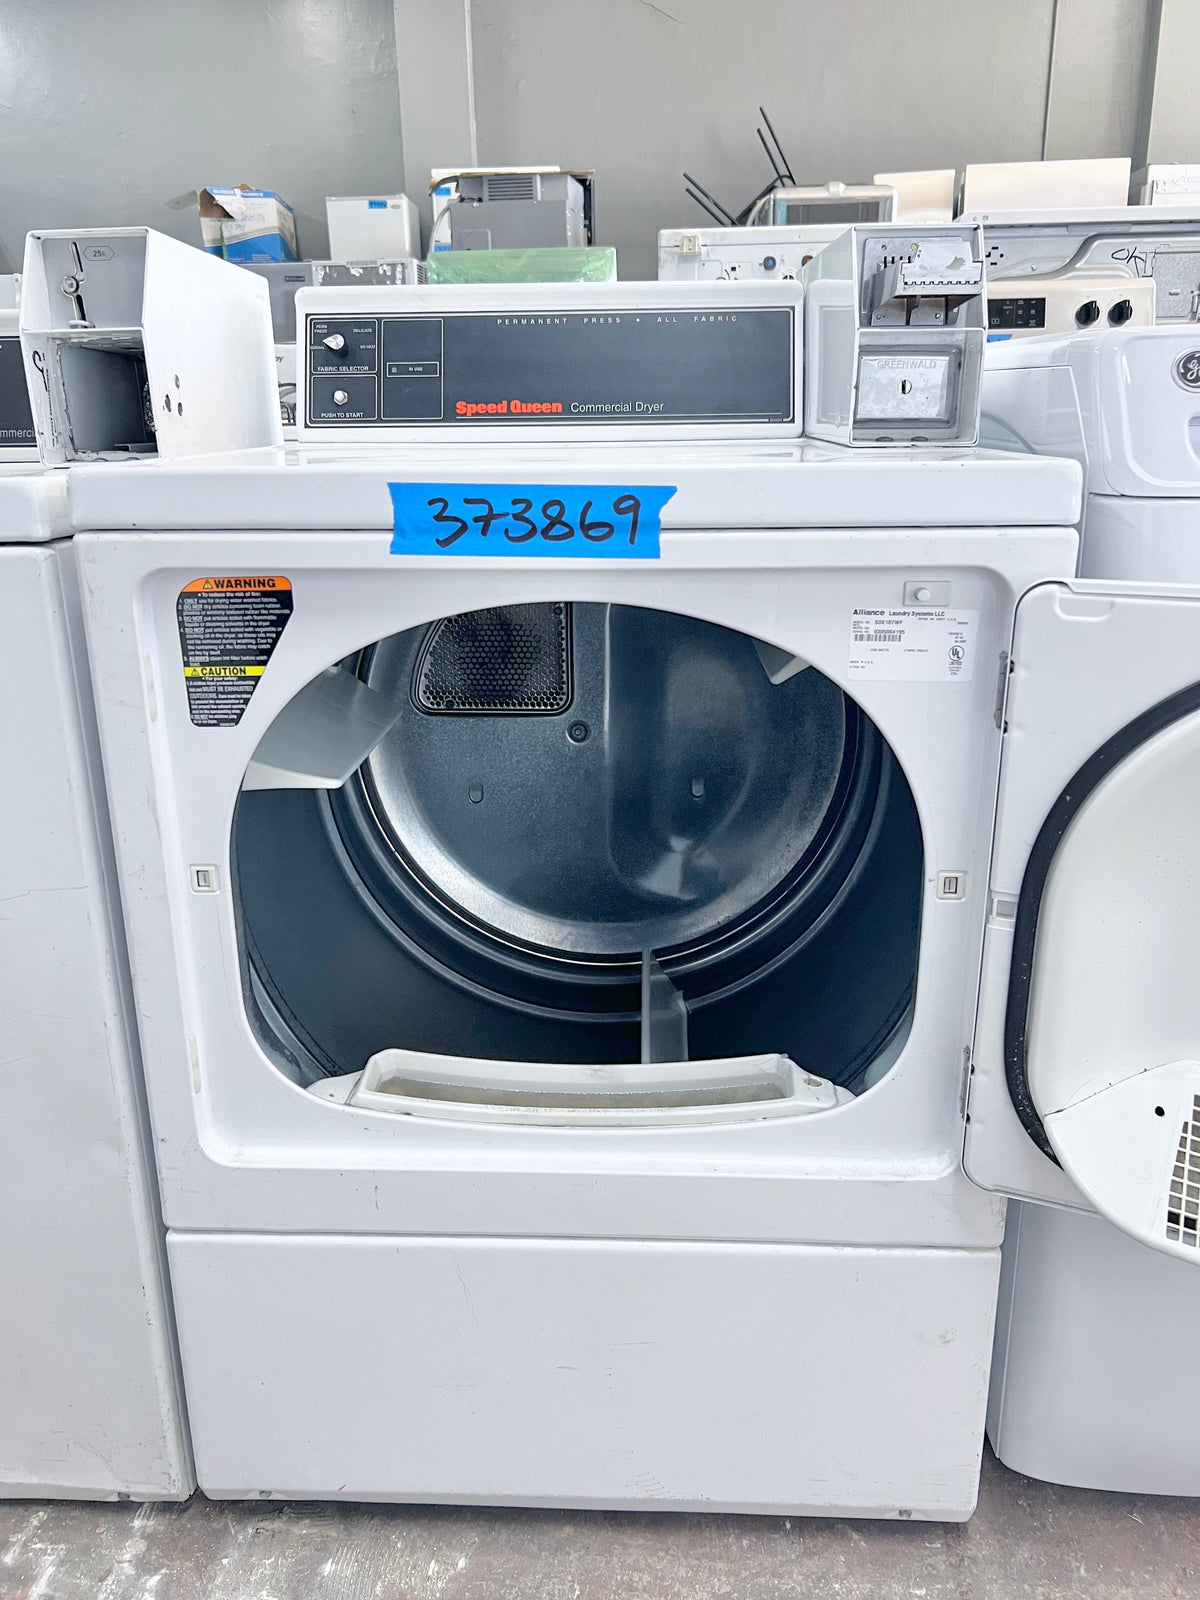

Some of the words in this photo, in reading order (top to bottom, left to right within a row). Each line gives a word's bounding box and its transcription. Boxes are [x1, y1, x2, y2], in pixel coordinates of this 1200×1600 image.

[877, 360, 936, 370] GREENWALD
[456, 400, 508, 417] Speed
[510, 399, 562, 413] Queen
[570, 402, 632, 413] Commercial
[635, 402, 664, 413] Dryer
[428, 494, 642, 548] 373869
[214, 579, 276, 588] WARNING
